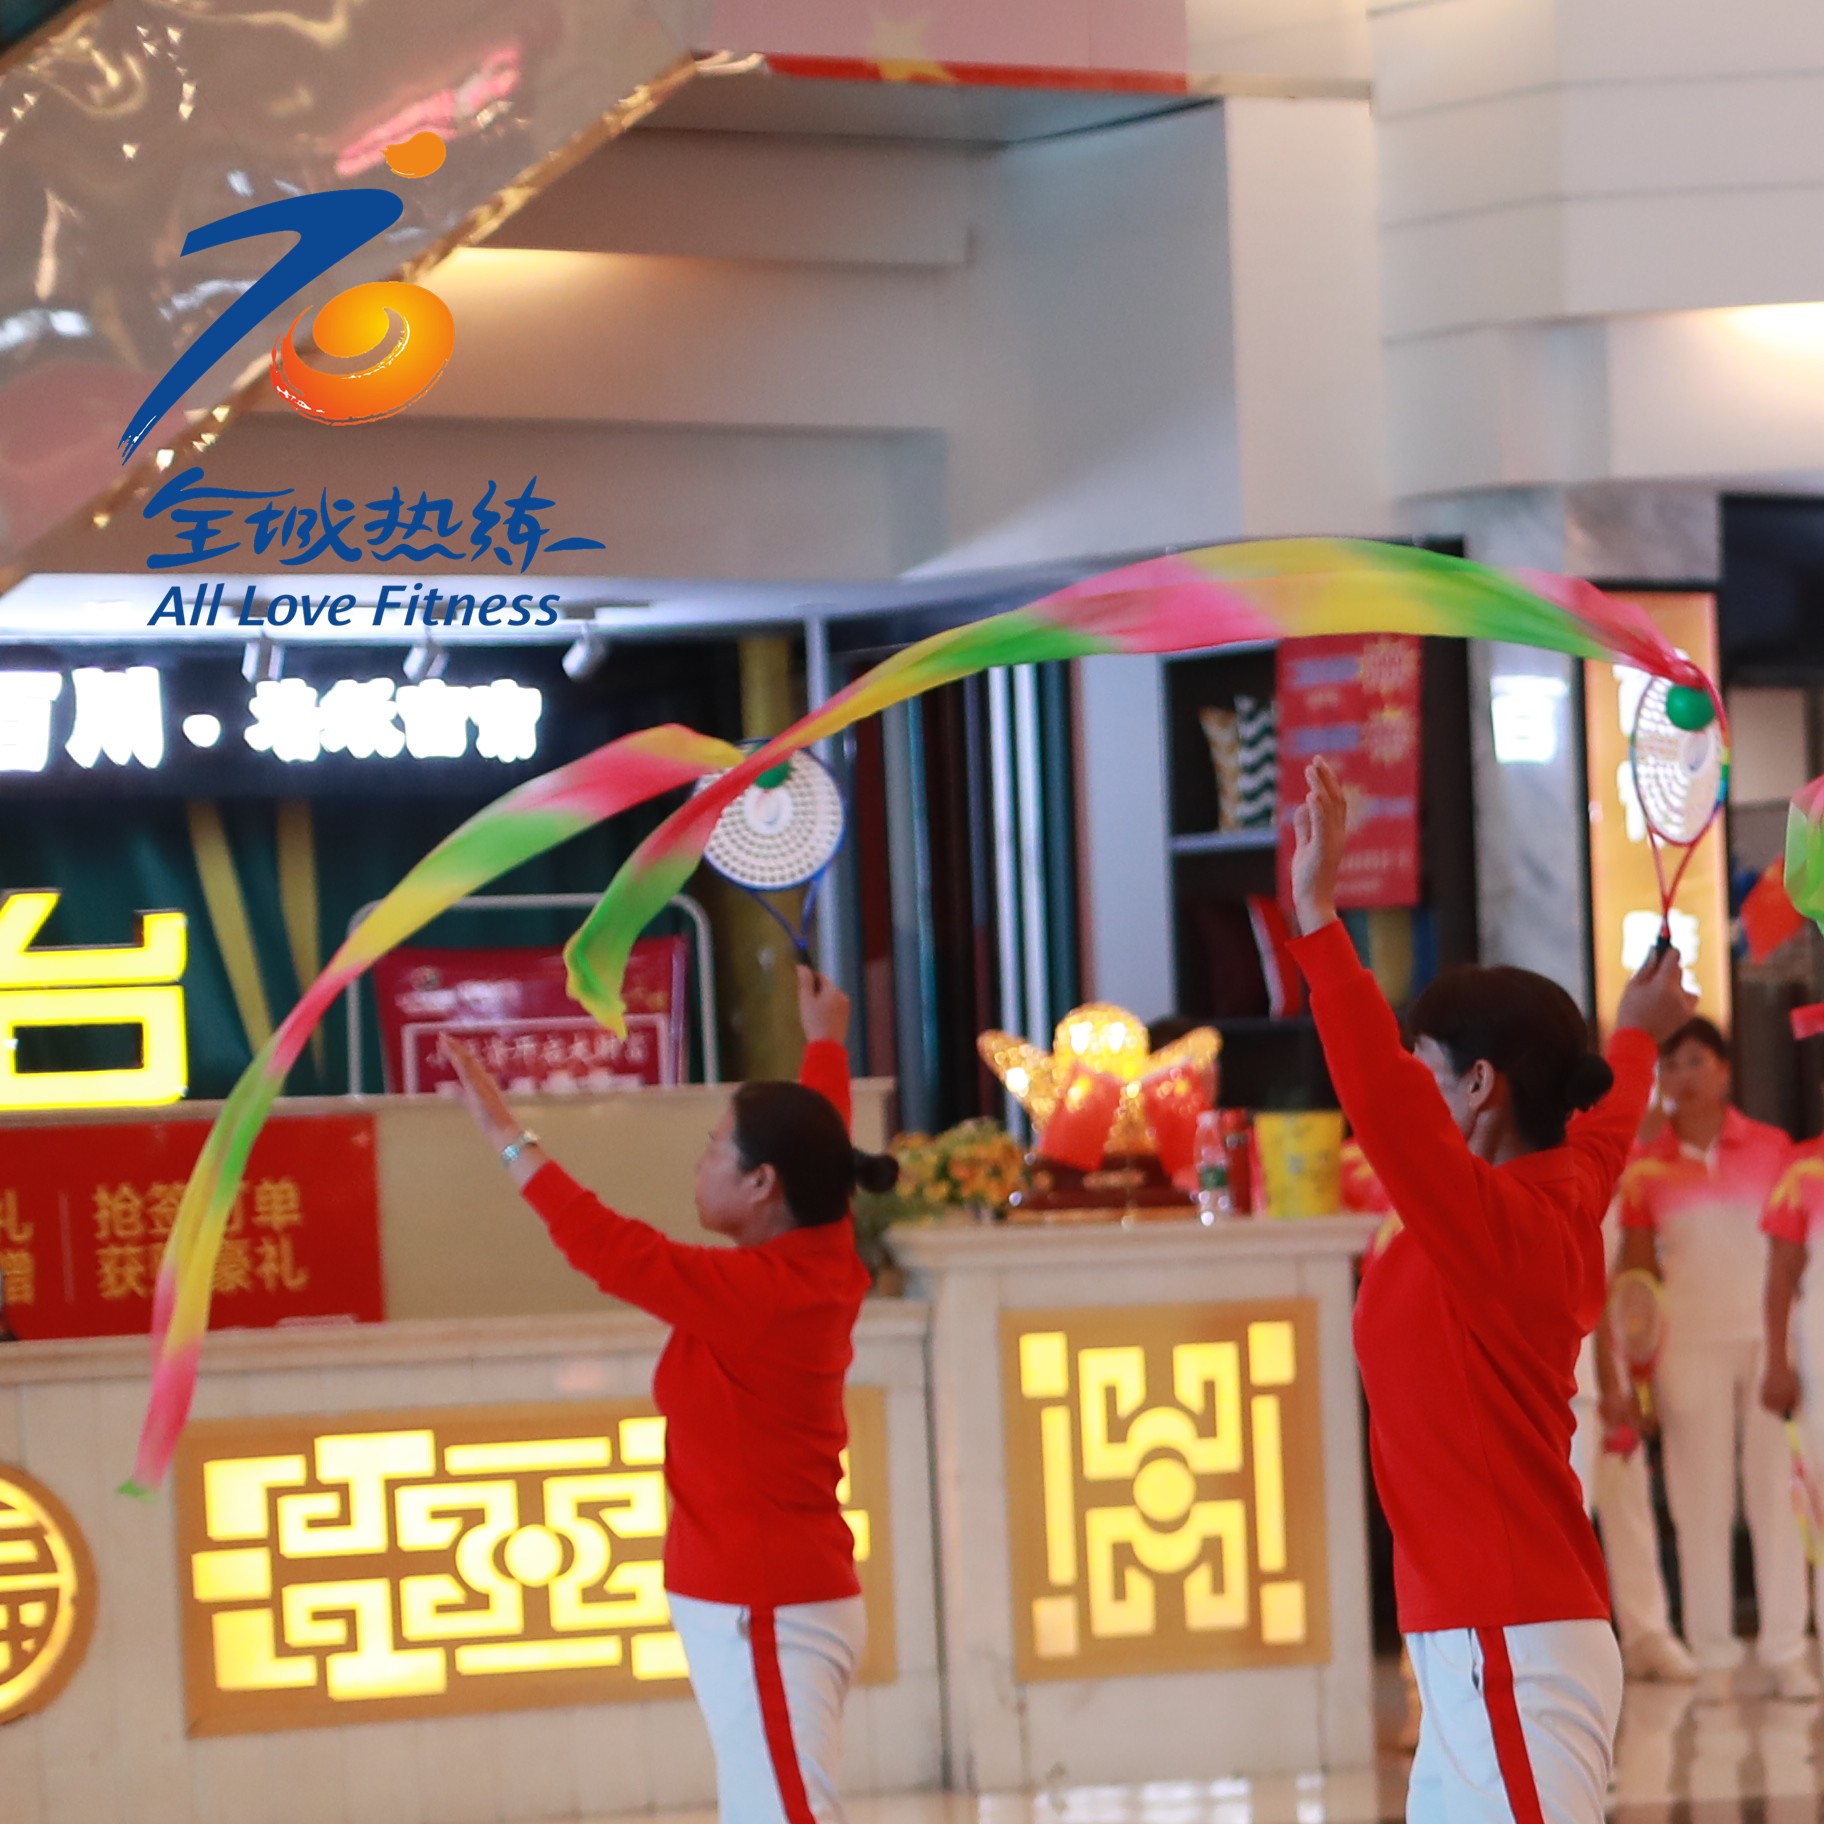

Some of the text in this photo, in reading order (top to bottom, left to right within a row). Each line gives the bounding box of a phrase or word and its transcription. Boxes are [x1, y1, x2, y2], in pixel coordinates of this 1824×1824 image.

[93, 1177, 304, 1241] 抢签单
[94, 1232, 309, 1300] 获豪礼
